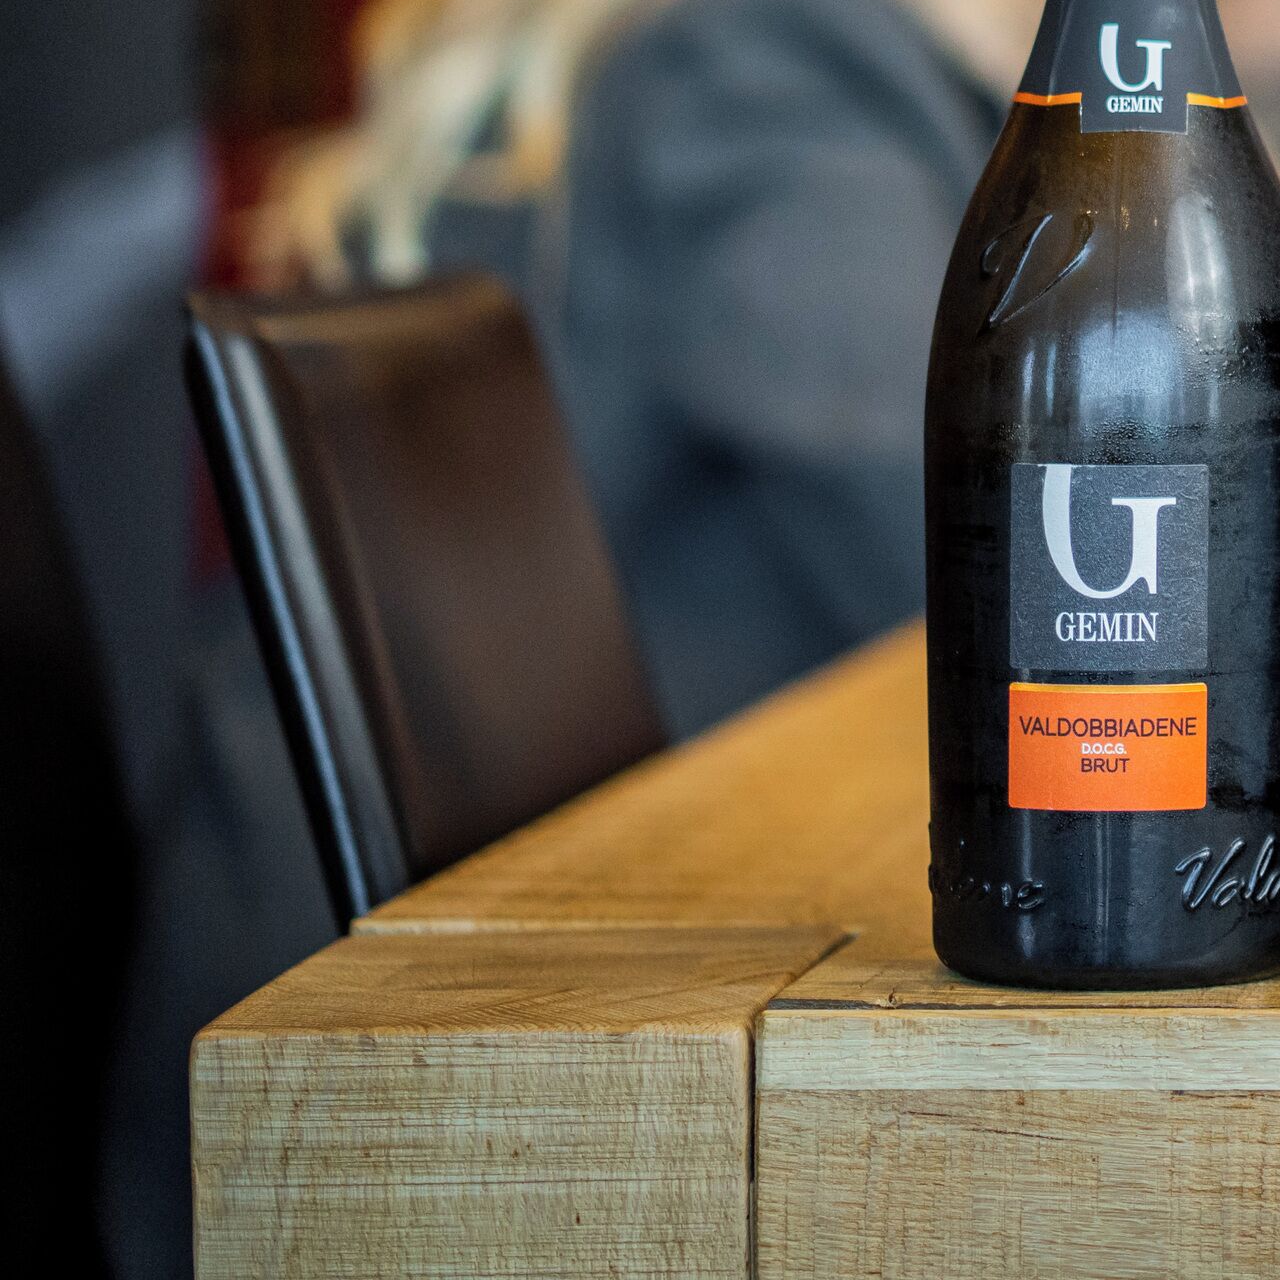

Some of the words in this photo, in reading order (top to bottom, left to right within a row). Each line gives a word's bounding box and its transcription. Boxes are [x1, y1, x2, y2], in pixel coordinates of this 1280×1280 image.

[1107, 96, 1163, 114] GEMIN
[1055, 612, 1159, 642] GEMIN
[1020, 716, 1196, 738] VALDOBBIADENE
[1081, 758, 1129, 773] BRUT
